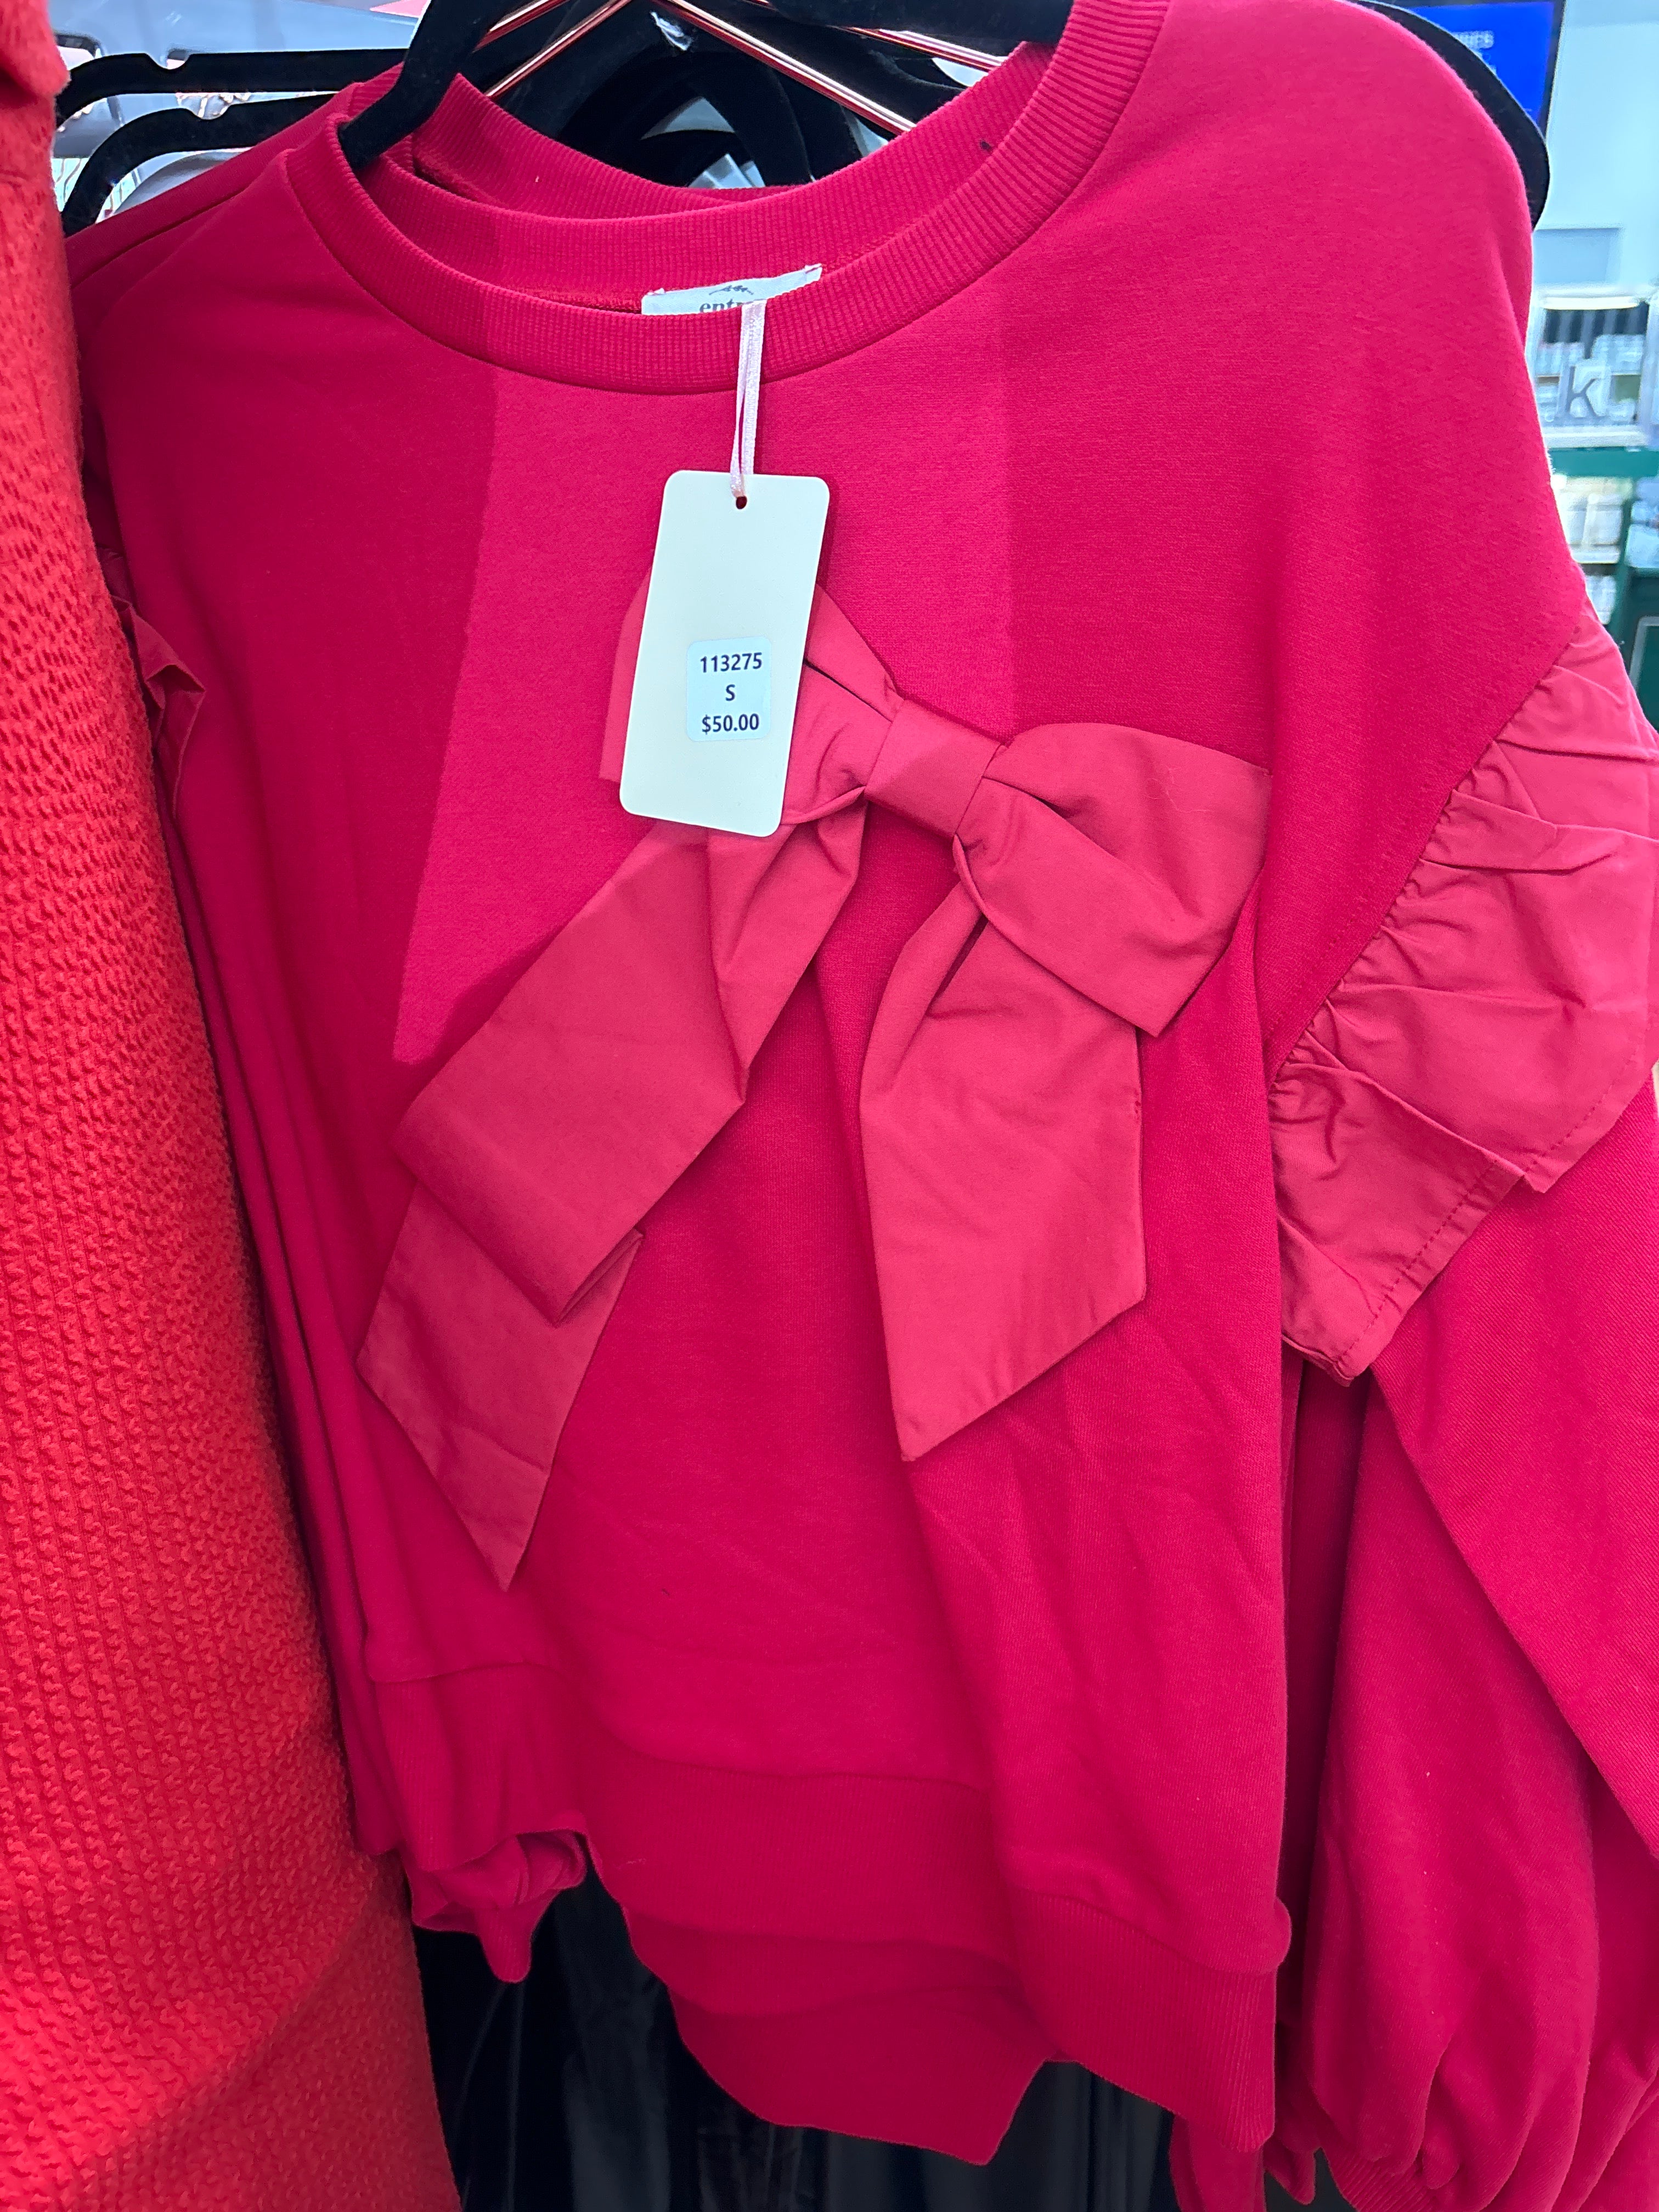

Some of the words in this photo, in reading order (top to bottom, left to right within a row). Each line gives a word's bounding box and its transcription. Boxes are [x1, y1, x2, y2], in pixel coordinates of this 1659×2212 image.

[700, 652, 763, 673] 113275
[725, 684, 736, 701] S
[702, 713, 760, 735] $50.00
